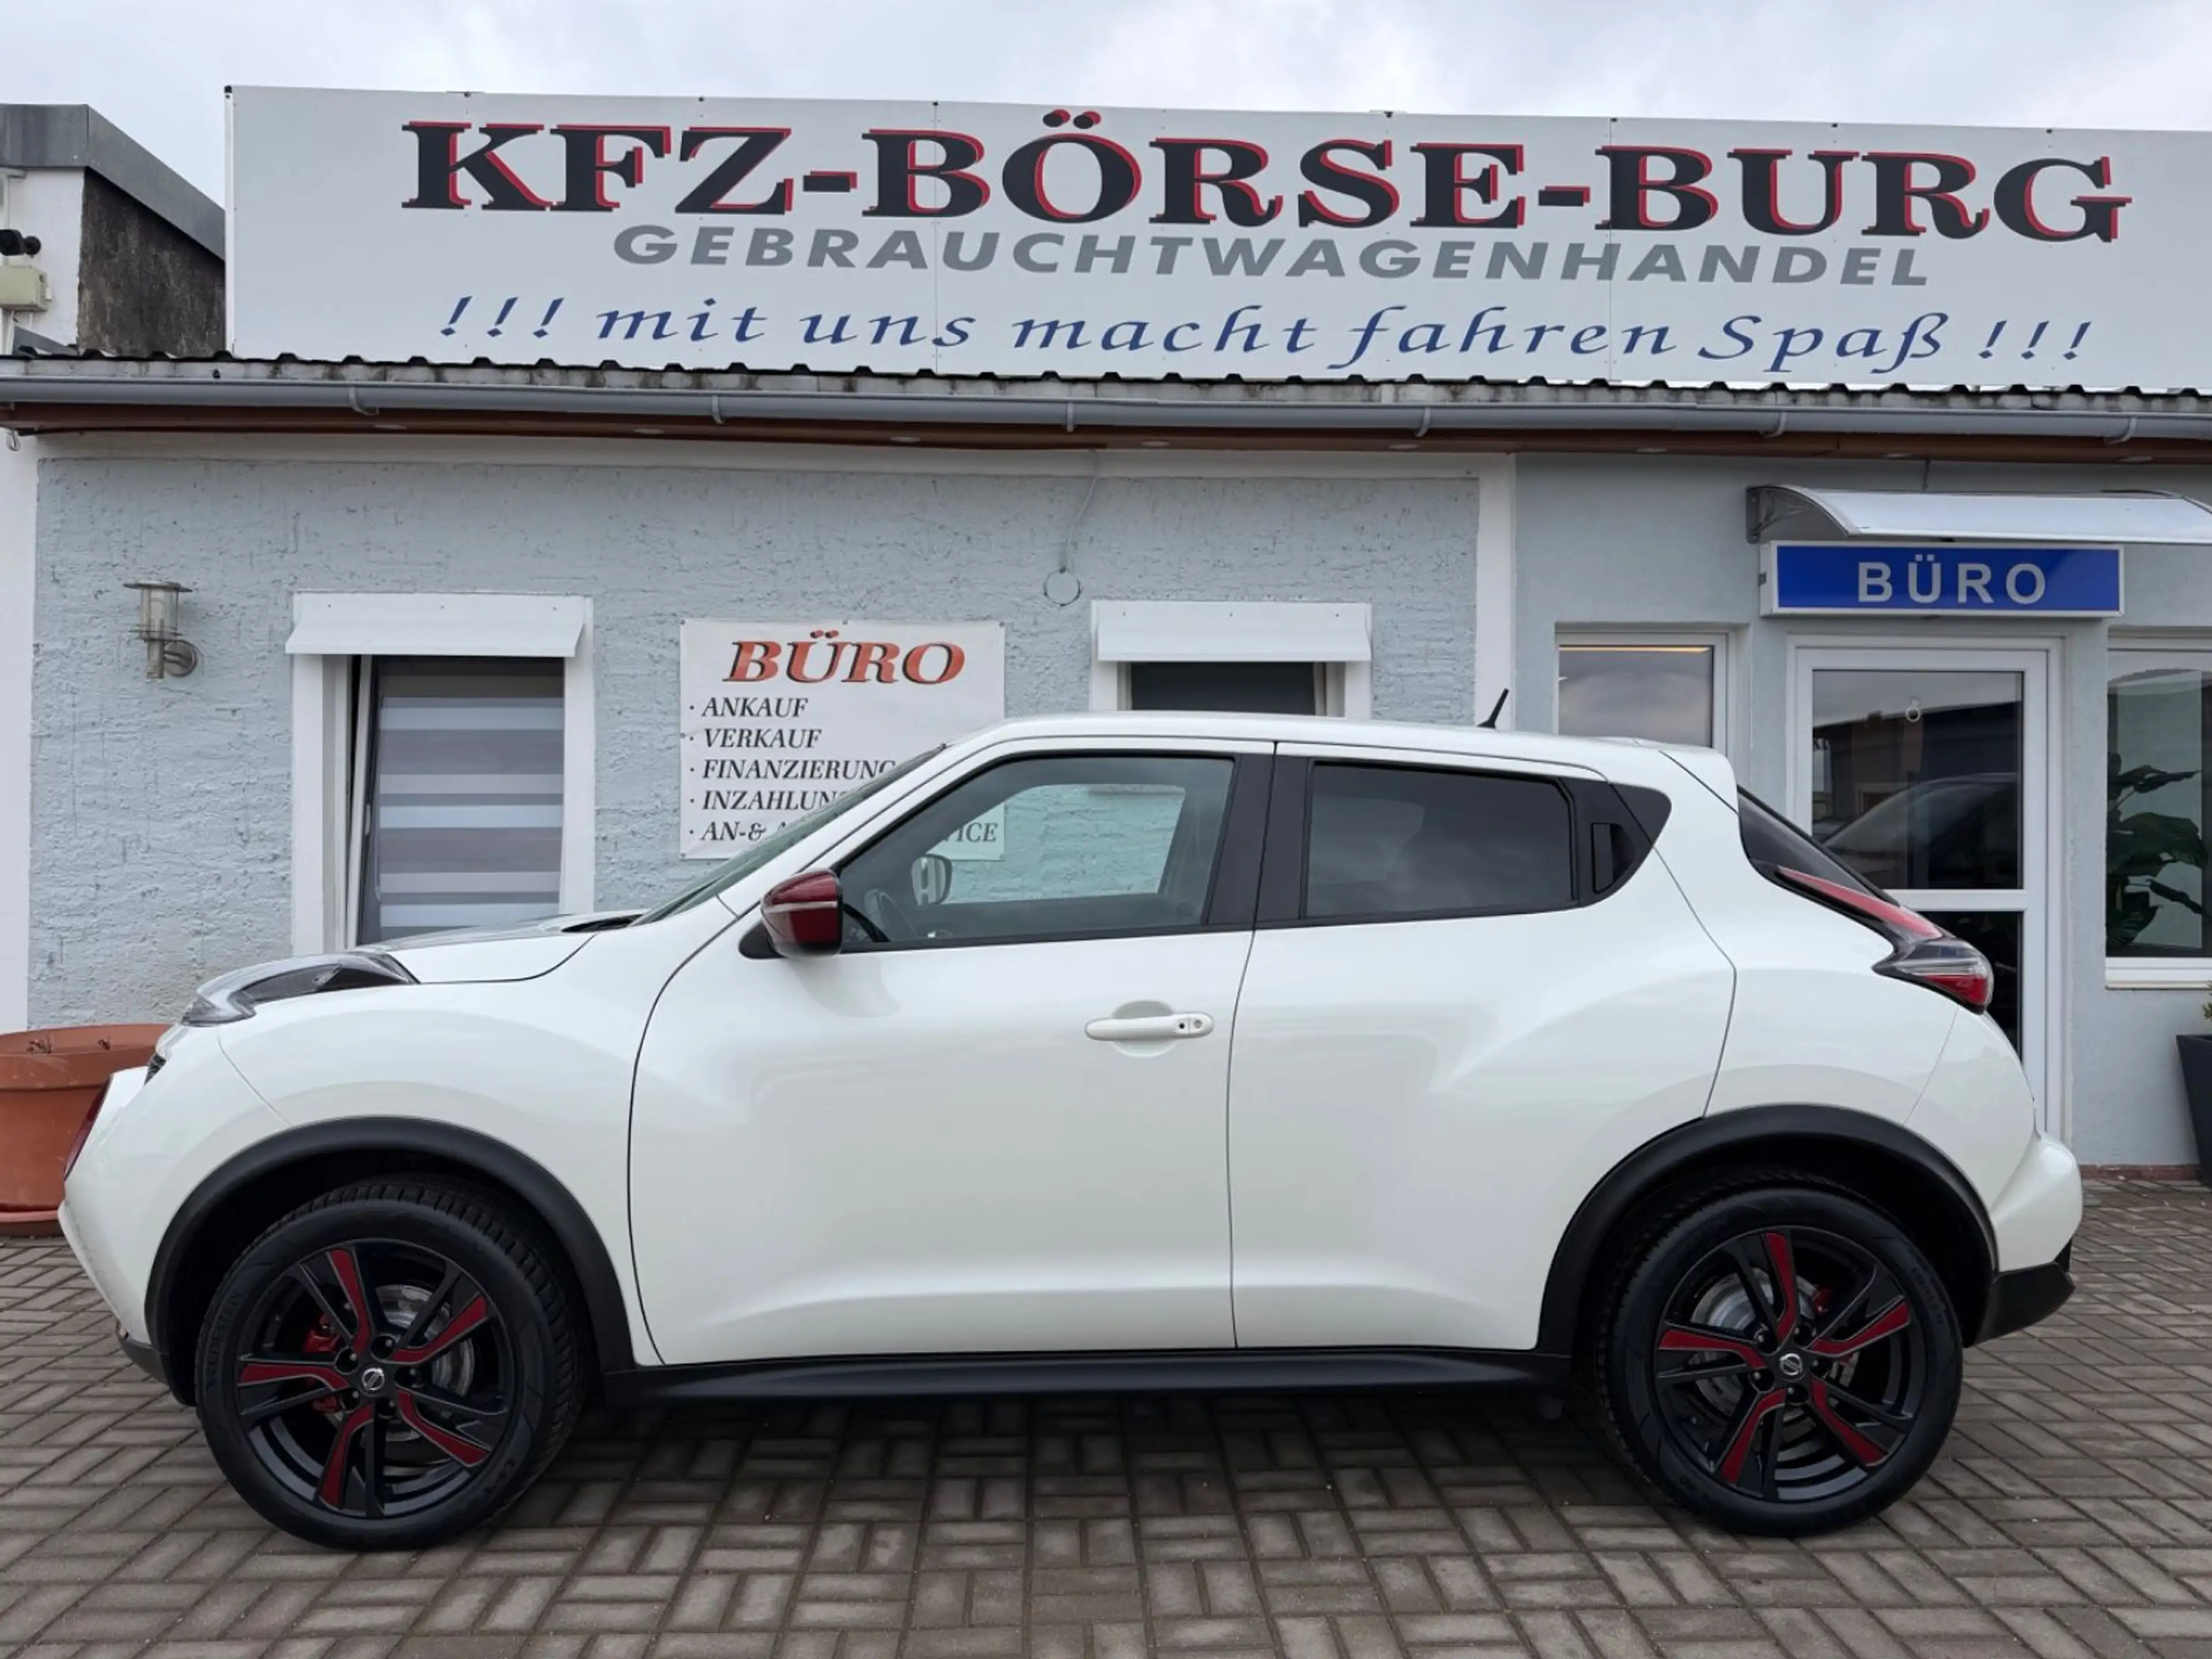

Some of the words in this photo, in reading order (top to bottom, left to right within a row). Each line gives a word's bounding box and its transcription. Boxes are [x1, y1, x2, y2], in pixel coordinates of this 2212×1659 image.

[402, 109, 2132, 243] KFZ-BÖRSE-BURG
[614, 225, 1929, 287] GEBRAUCHTWAGENHANDEL
[441, 296, 564, 339] !!!
[597, 298, 766, 343] mit
[801, 314, 976, 347] uns
[1013, 305, 1316, 355] macht
[1328, 305, 1675, 370] fahren
[1697, 312, 1950, 374] Spaß
[1979, 320, 2092, 360] !!!
[1858, 554, 2046, 605] BÜRO
[721, 629, 965, 685] BÜRO
[701, 696, 808, 718] ANKAUF
[704, 728, 822, 749] VERKAUF
[702, 790, 849, 810] INZAHLUN
